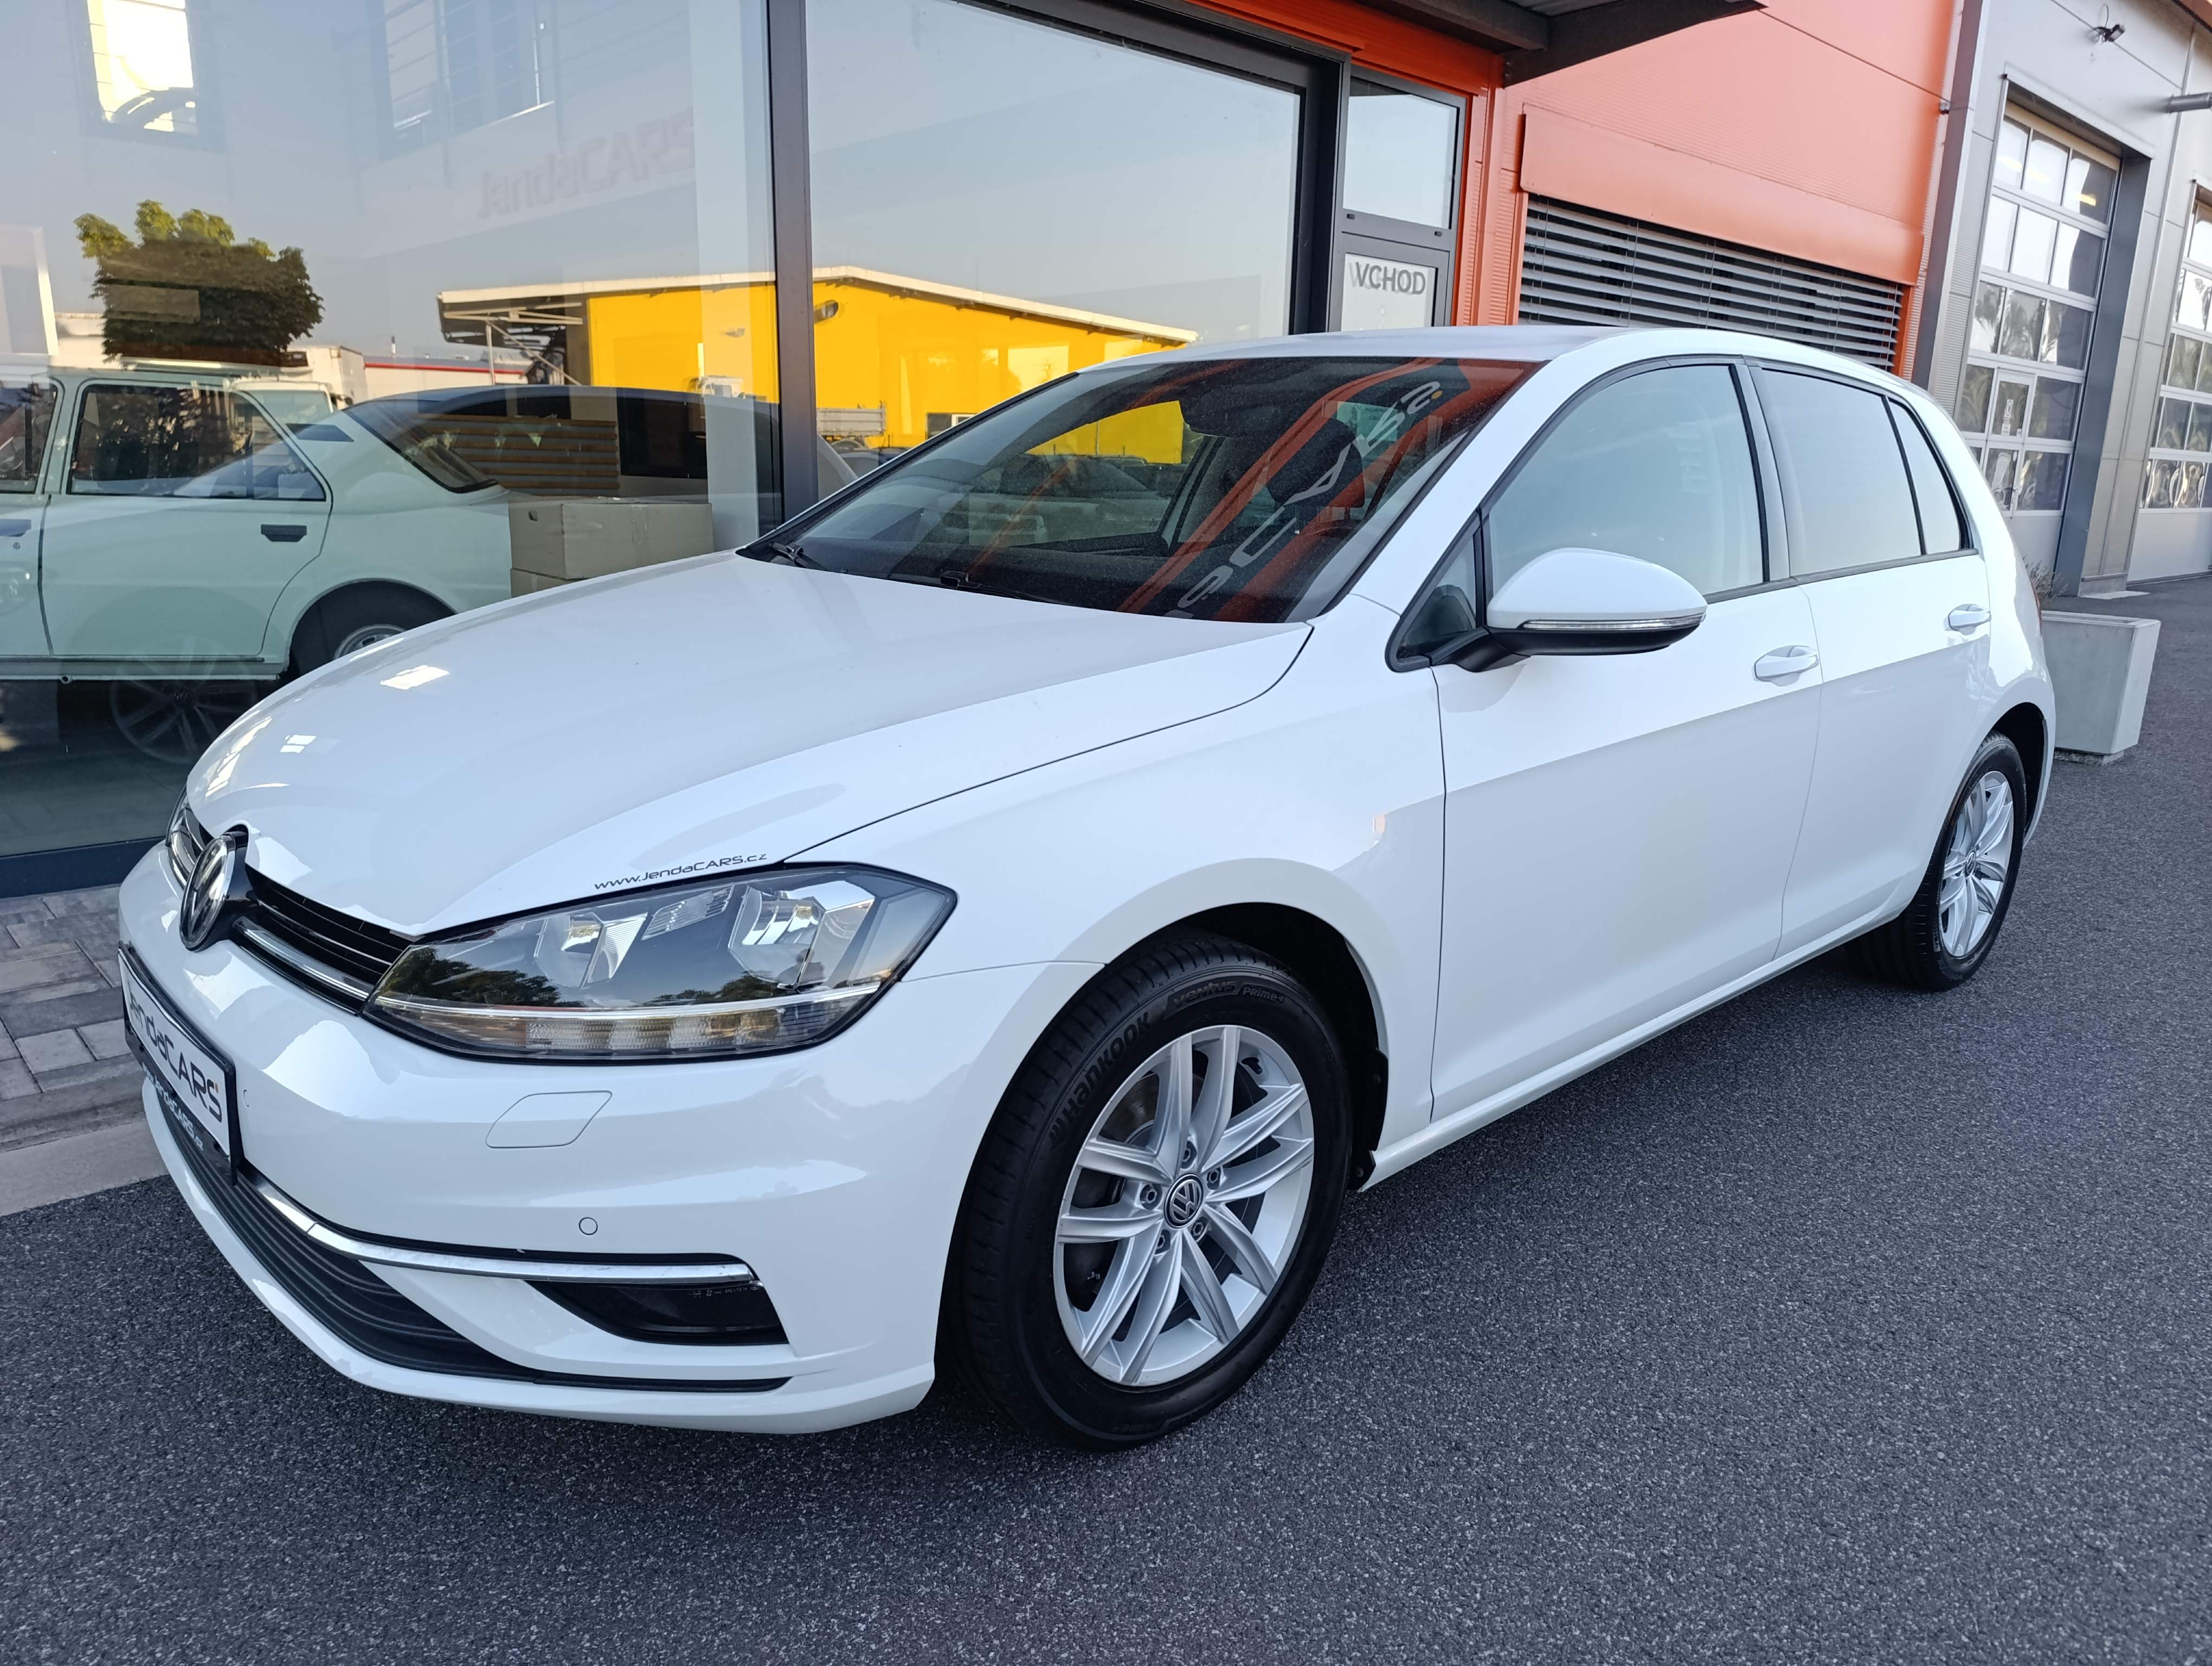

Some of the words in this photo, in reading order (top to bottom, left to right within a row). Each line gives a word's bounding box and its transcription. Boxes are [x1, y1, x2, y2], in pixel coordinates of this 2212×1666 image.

[1355, 261, 1426, 295] VCHOD
[594, 853, 767, 890] www.JendaCARS.cz
[127, 979, 222, 1123] JendaCARS
